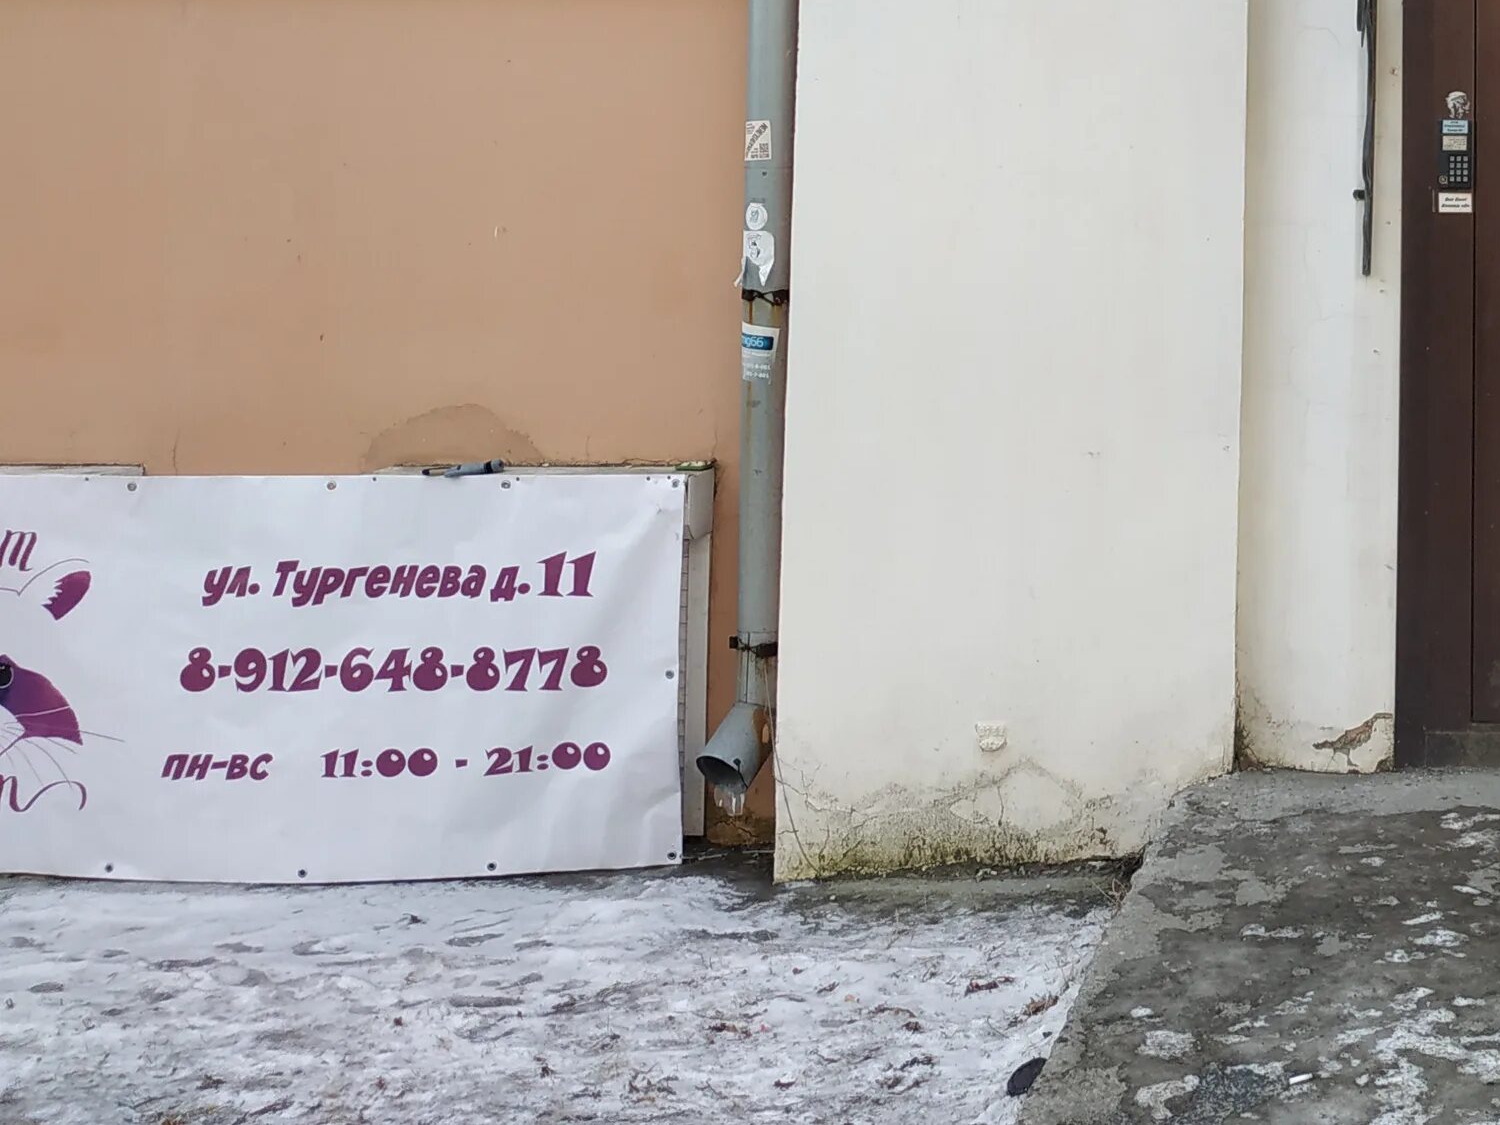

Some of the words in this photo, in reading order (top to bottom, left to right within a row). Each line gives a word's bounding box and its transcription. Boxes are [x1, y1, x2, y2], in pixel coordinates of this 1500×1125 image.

[201, 566, 260, 607] ул.
[272, 559, 487, 607] Тургенева
[179, 644, 609, 694] 8-912-648-8778
[161, 752, 274, 782] пн-вс
[320, 747, 439, 779] 11:00
[483, 741, 612, 777] 21:00
